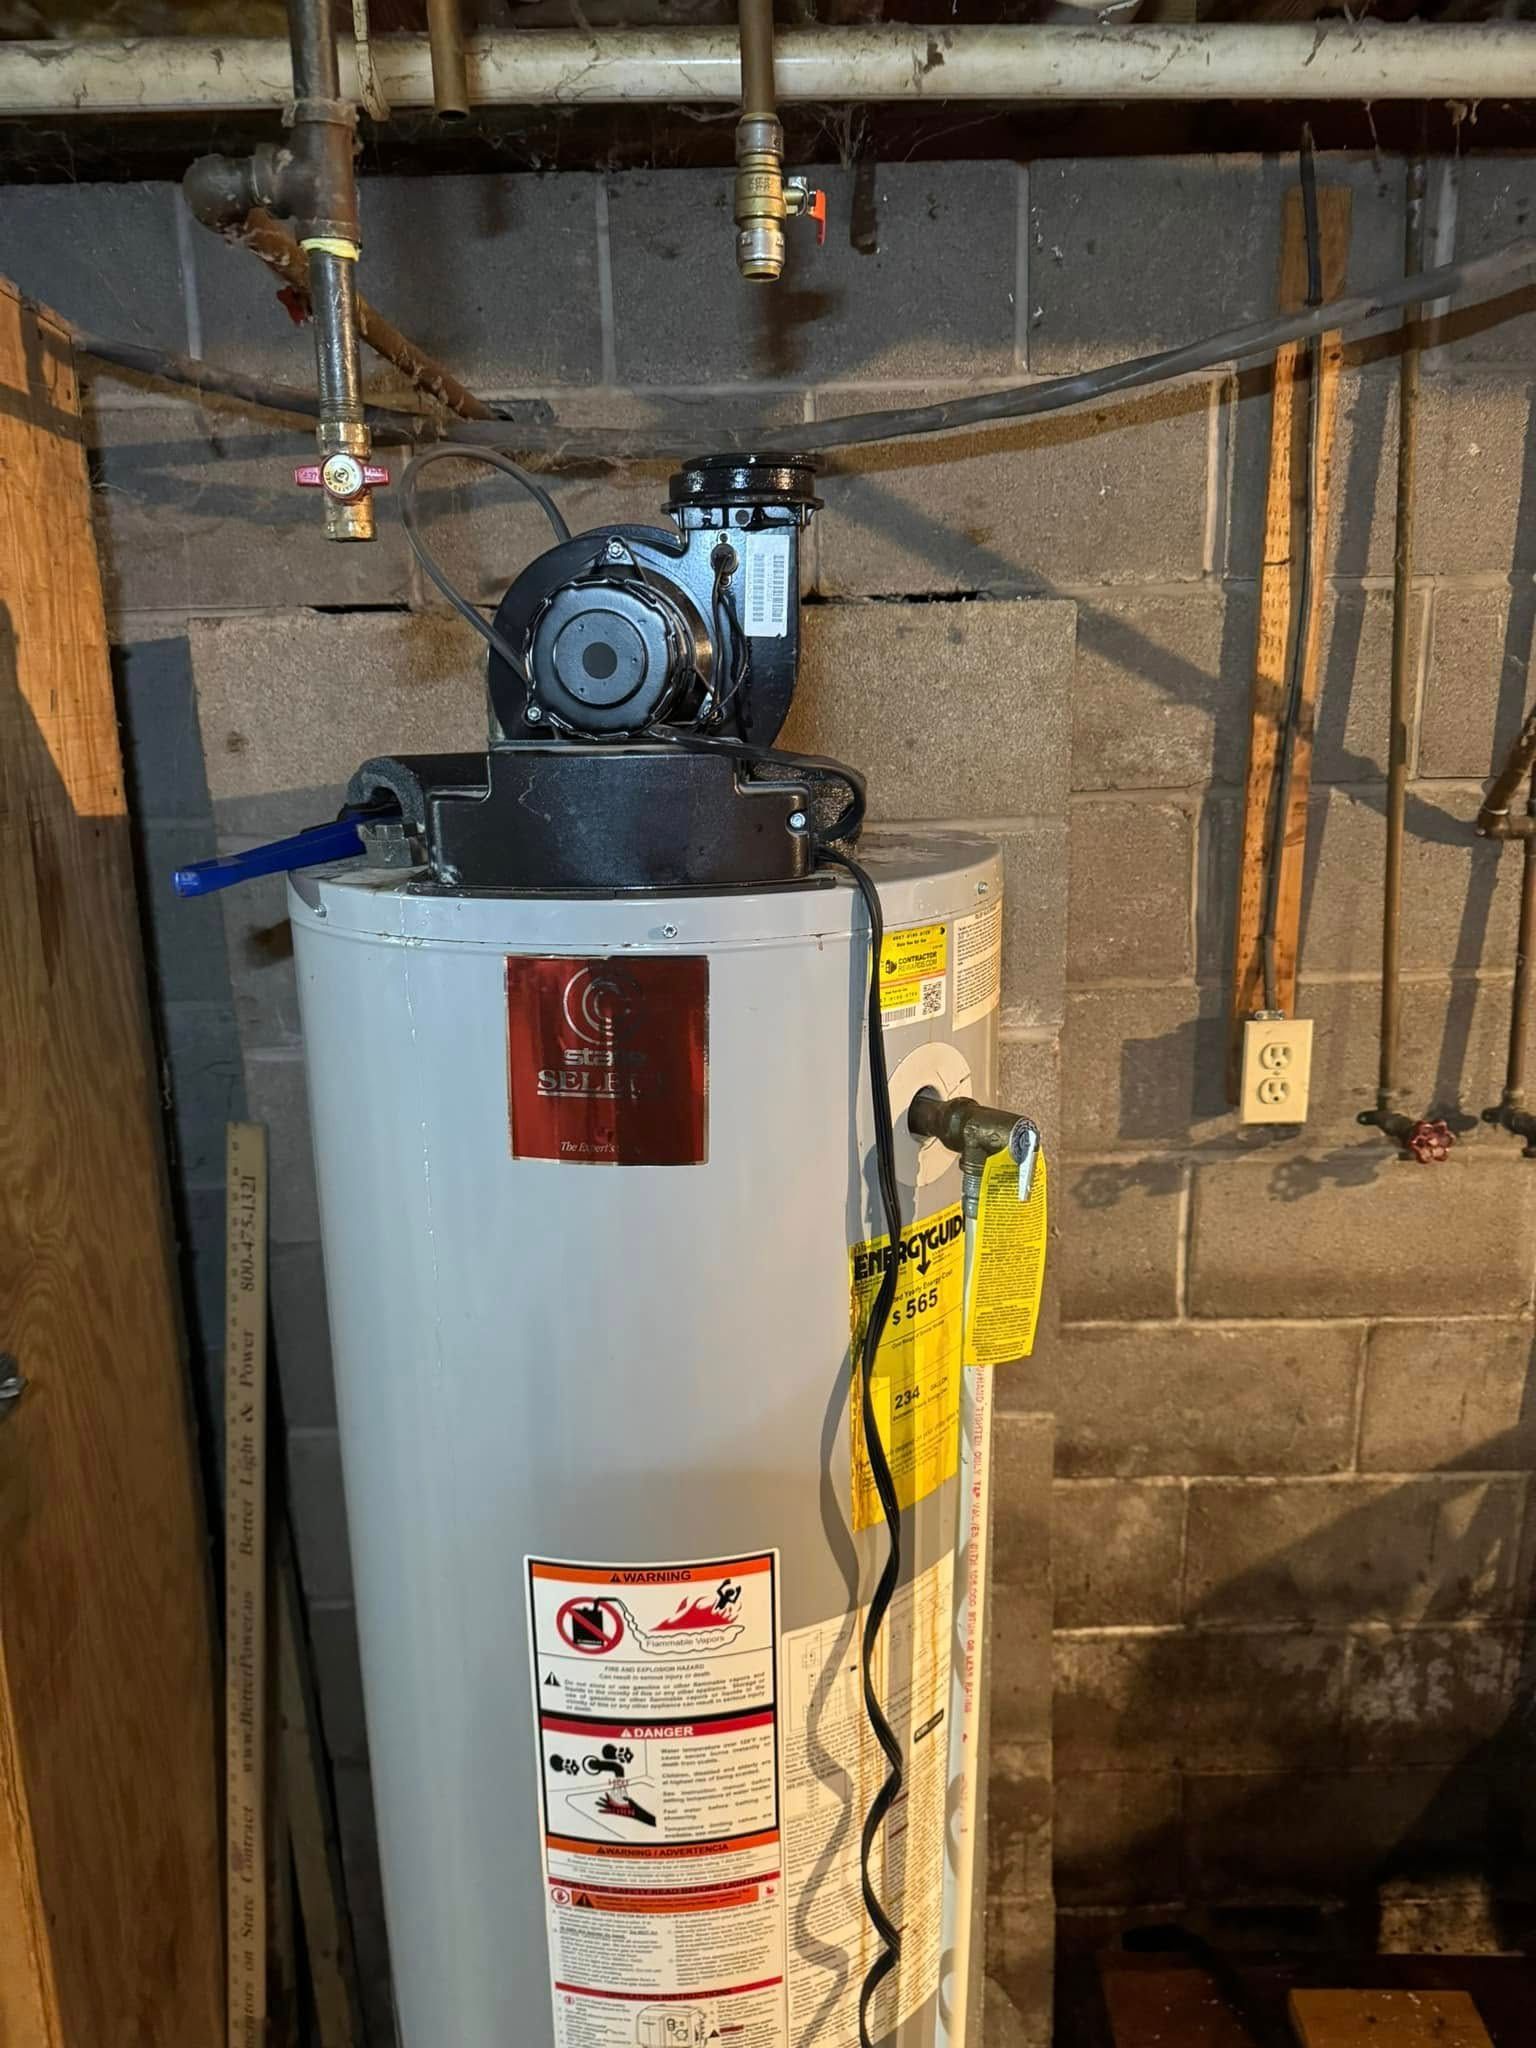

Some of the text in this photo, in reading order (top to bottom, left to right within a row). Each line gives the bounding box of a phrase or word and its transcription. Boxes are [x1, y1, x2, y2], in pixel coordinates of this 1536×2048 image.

[560, 1142, 578, 1152] The
[239, 1175, 256, 1293] 800-475-1321
[906, 1288, 938, 1319] 565
[894, 1386, 920, 1410] 234
[239, 1328, 256, 1557] Better Light & Power
[973, 1452, 982, 1476] ONLY
[623, 1570, 692, 1584] WARNING
[646, 1636, 725, 1648] Flammable Vapors
[634, 1726, 694, 1738] DANGER
[239, 1805, 254, 1884] Contract
[606, 1848, 651, 1856] WARNING
[661, 1844, 728, 1856] ADVERTENCIA
[240, 1895, 254, 1940] State
[242, 1951, 254, 1972] on
